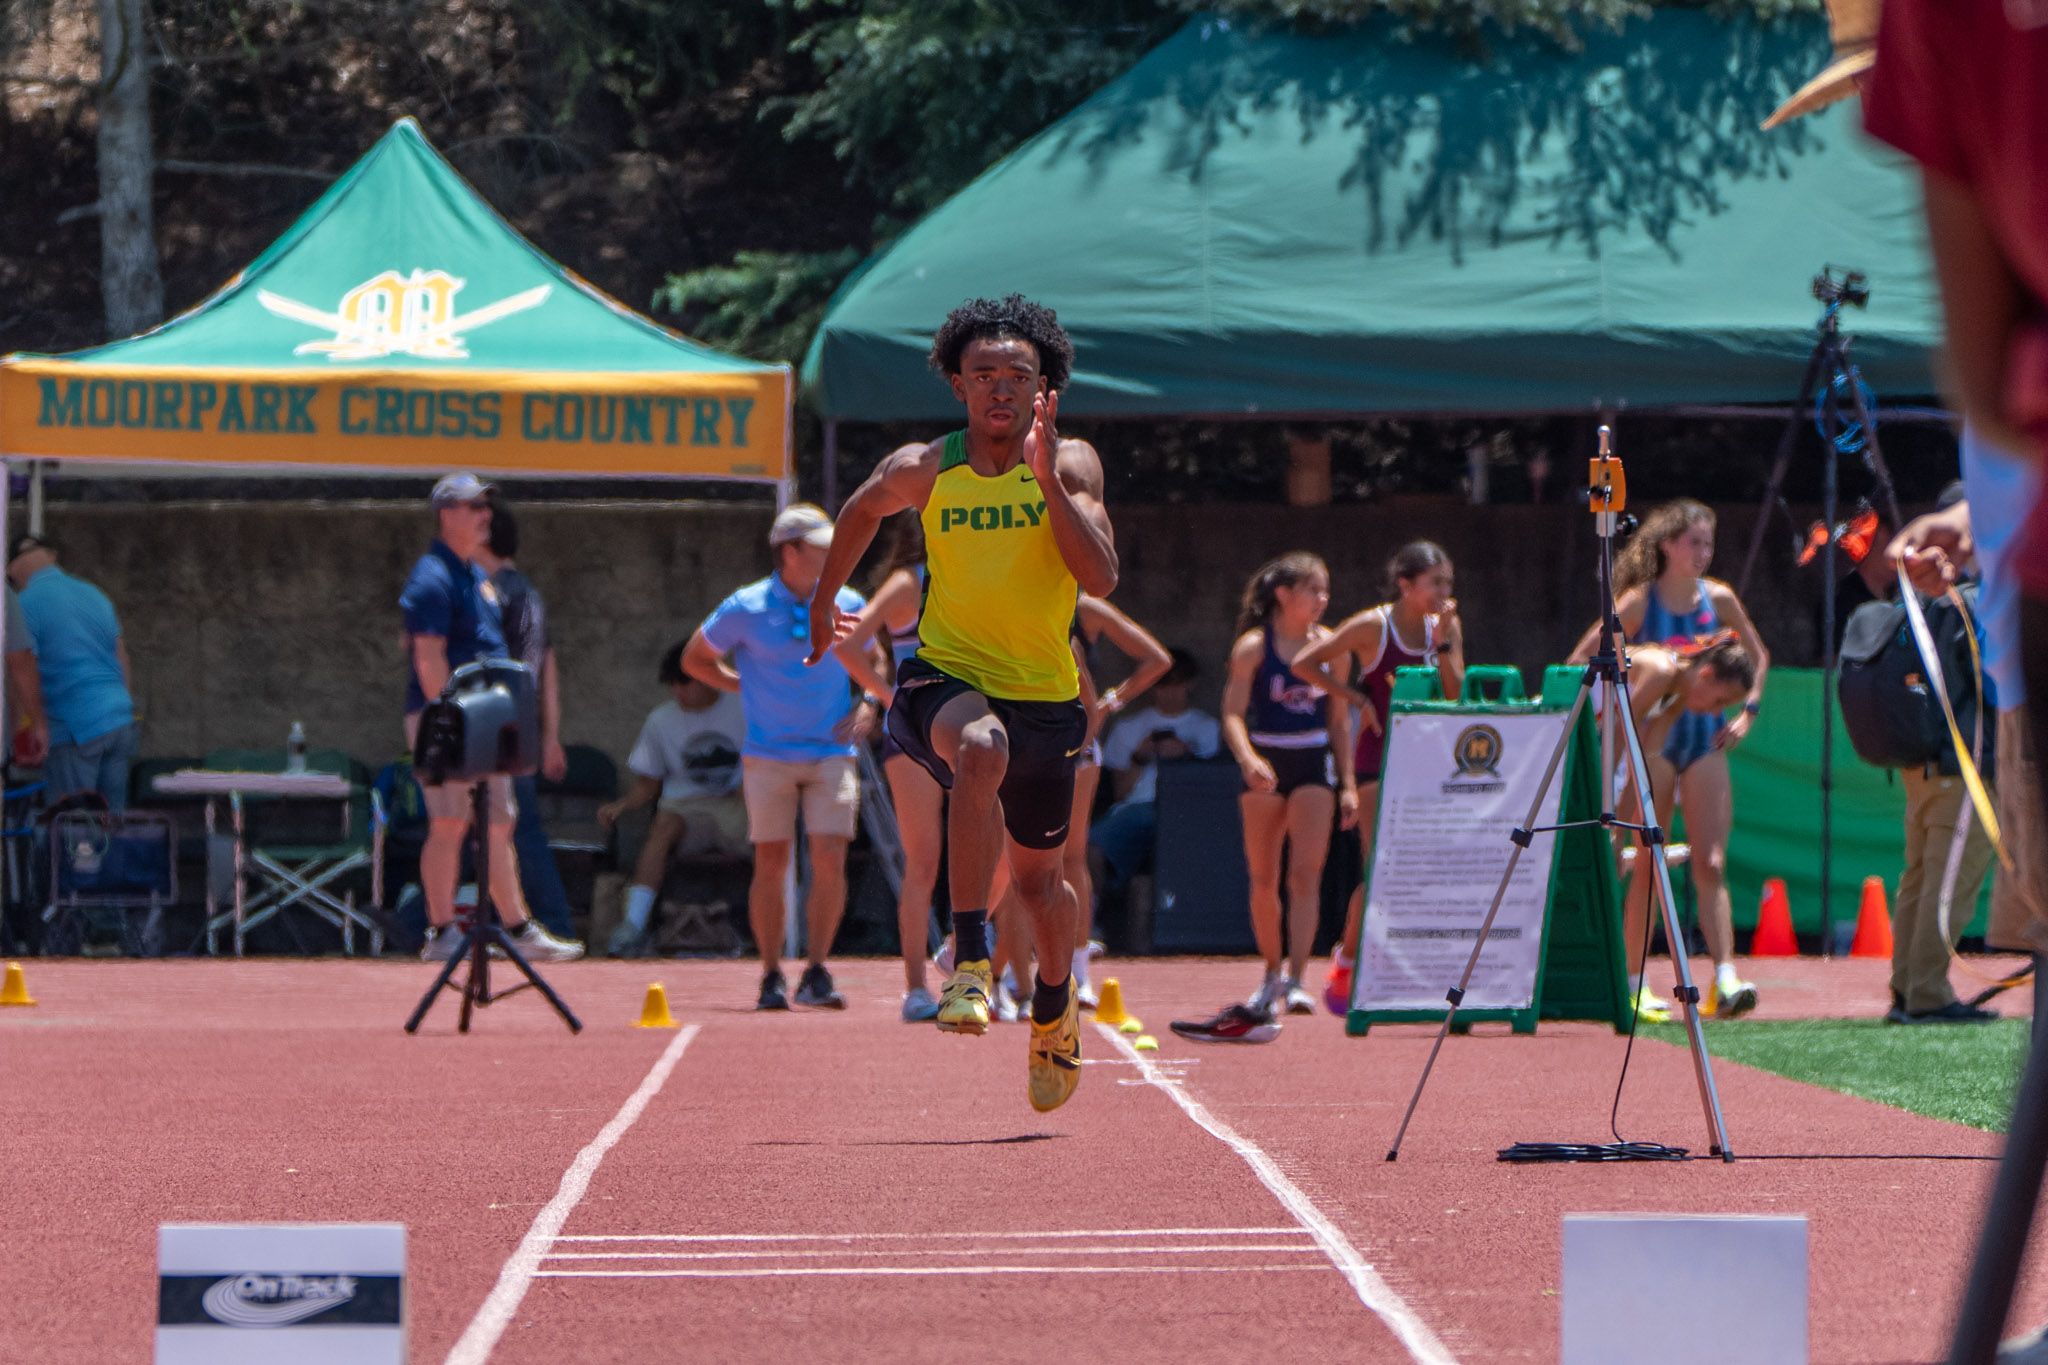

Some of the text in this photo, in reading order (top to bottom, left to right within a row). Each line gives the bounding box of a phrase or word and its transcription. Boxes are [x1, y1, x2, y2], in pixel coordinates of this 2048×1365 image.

[37, 376, 755, 447] MOORPARK CROSS COUNTRY
[941, 501, 1046, 532] POLY
